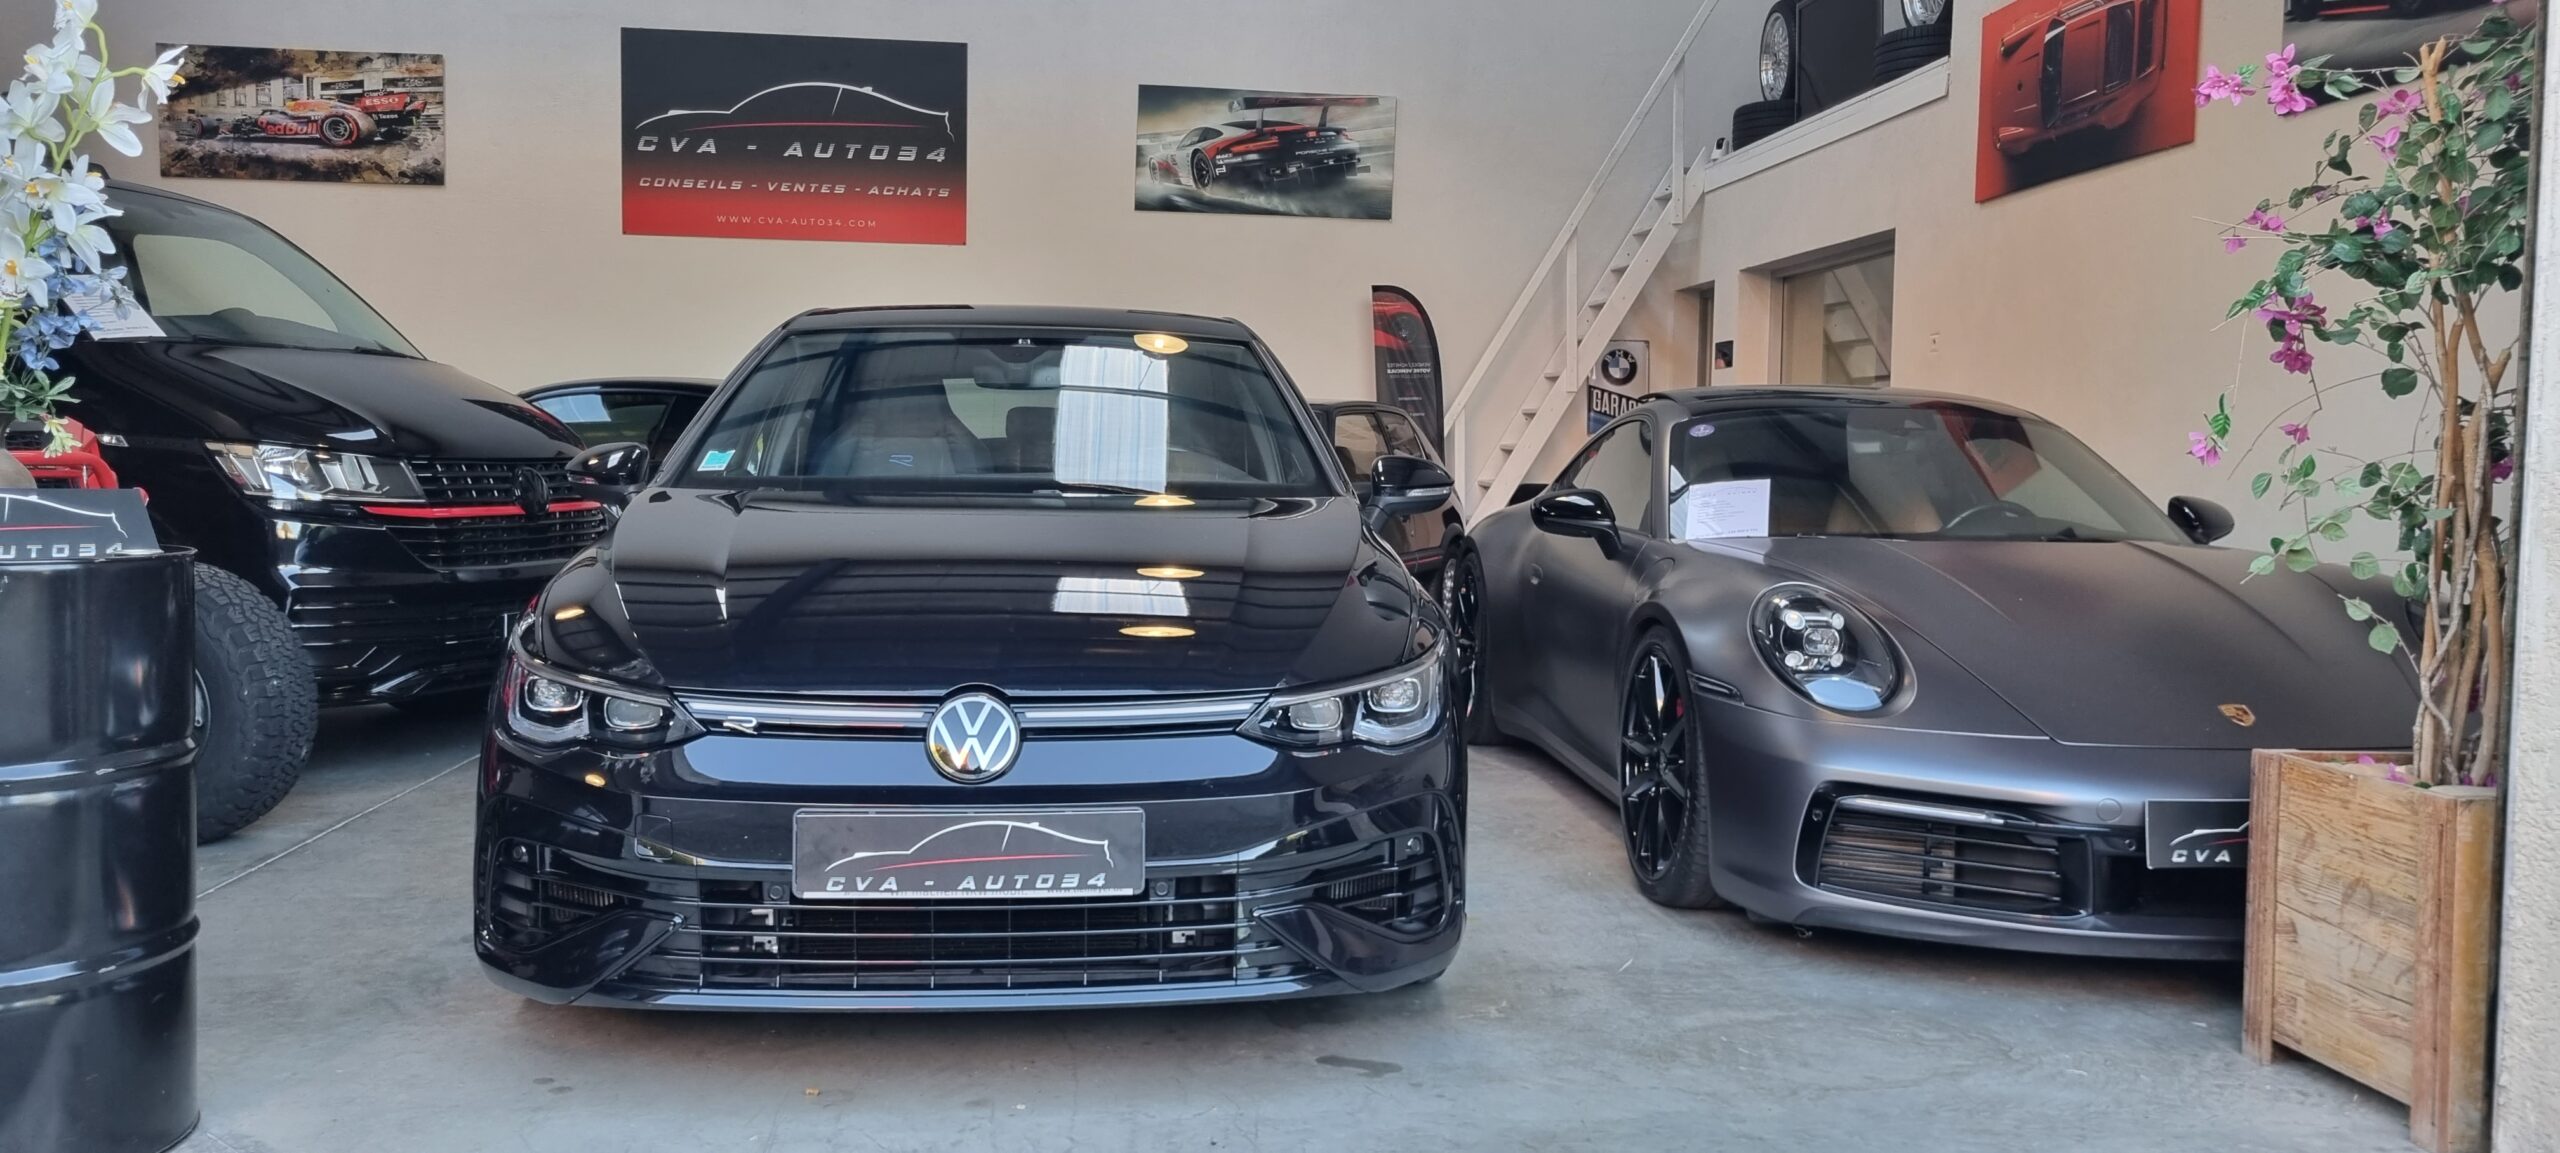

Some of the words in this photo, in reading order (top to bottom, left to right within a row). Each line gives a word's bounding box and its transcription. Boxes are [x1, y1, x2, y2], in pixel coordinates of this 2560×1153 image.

[365, 97, 399, 106] ESSO
[637, 135, 717, 154] CVA
[783, 141, 947, 163] AUTO34
[639, 177, 744, 190] CONSEILS
[767, 181, 847, 194] VENTES
[868, 185, 951, 198] ACHATS
[716, 215, 877, 228] WWW.CVA-AUTO34.COM
[1604, 350, 1636, 363] BMW
[1592, 388, 1640, 418] GARA
[2171, 849, 2231, 863] CVA
[826, 876, 898, 892] CVA
[956, 872, 1106, 890] AUTO34
